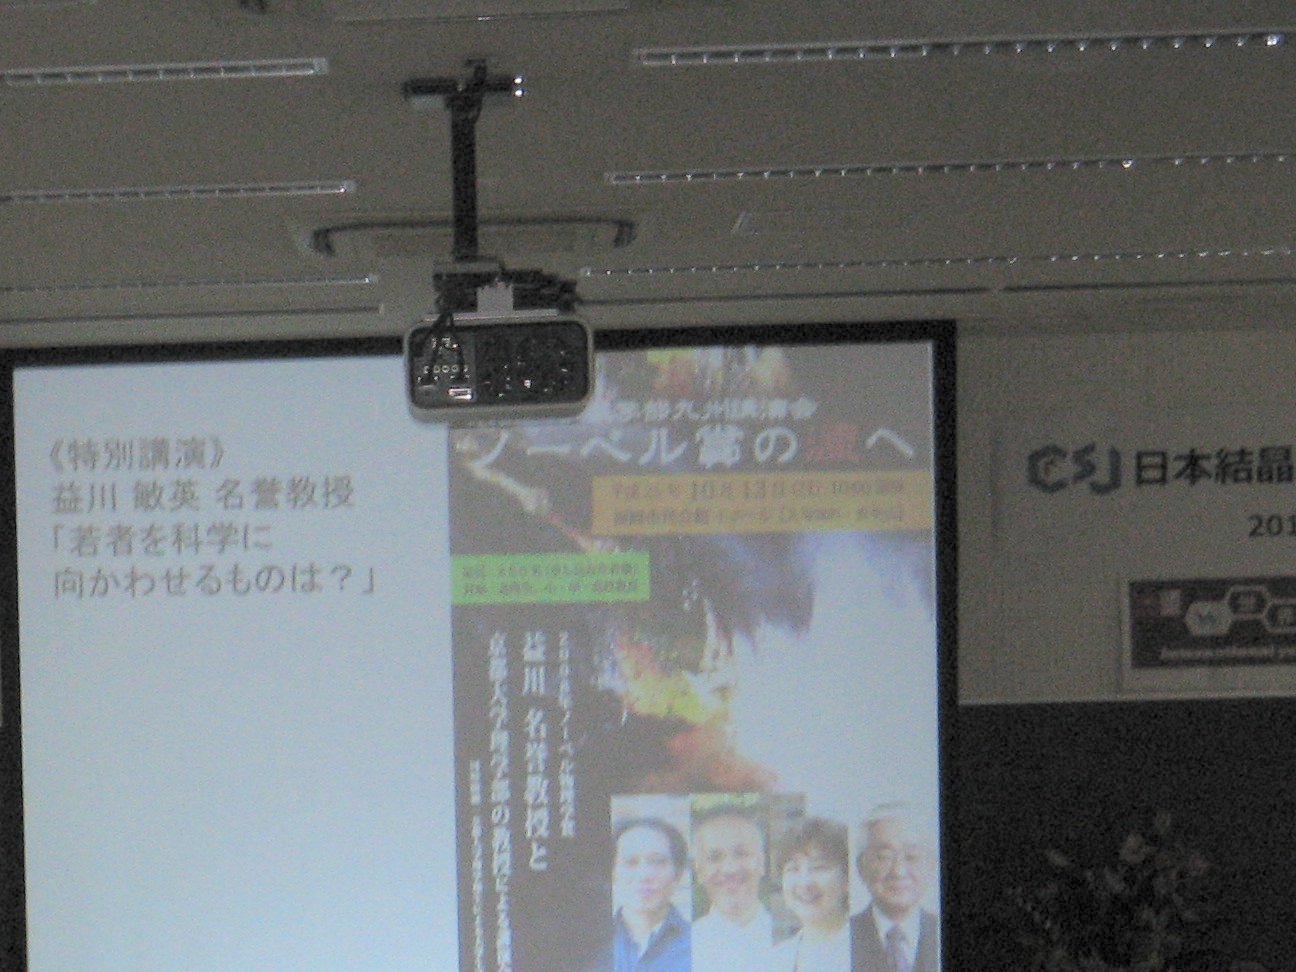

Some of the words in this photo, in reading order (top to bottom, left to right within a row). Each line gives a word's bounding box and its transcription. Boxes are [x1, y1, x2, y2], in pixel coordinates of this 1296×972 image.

[1027, 443, 1122, 494] CSJ
[1135, 445, 1296, 486] 日本結晶
